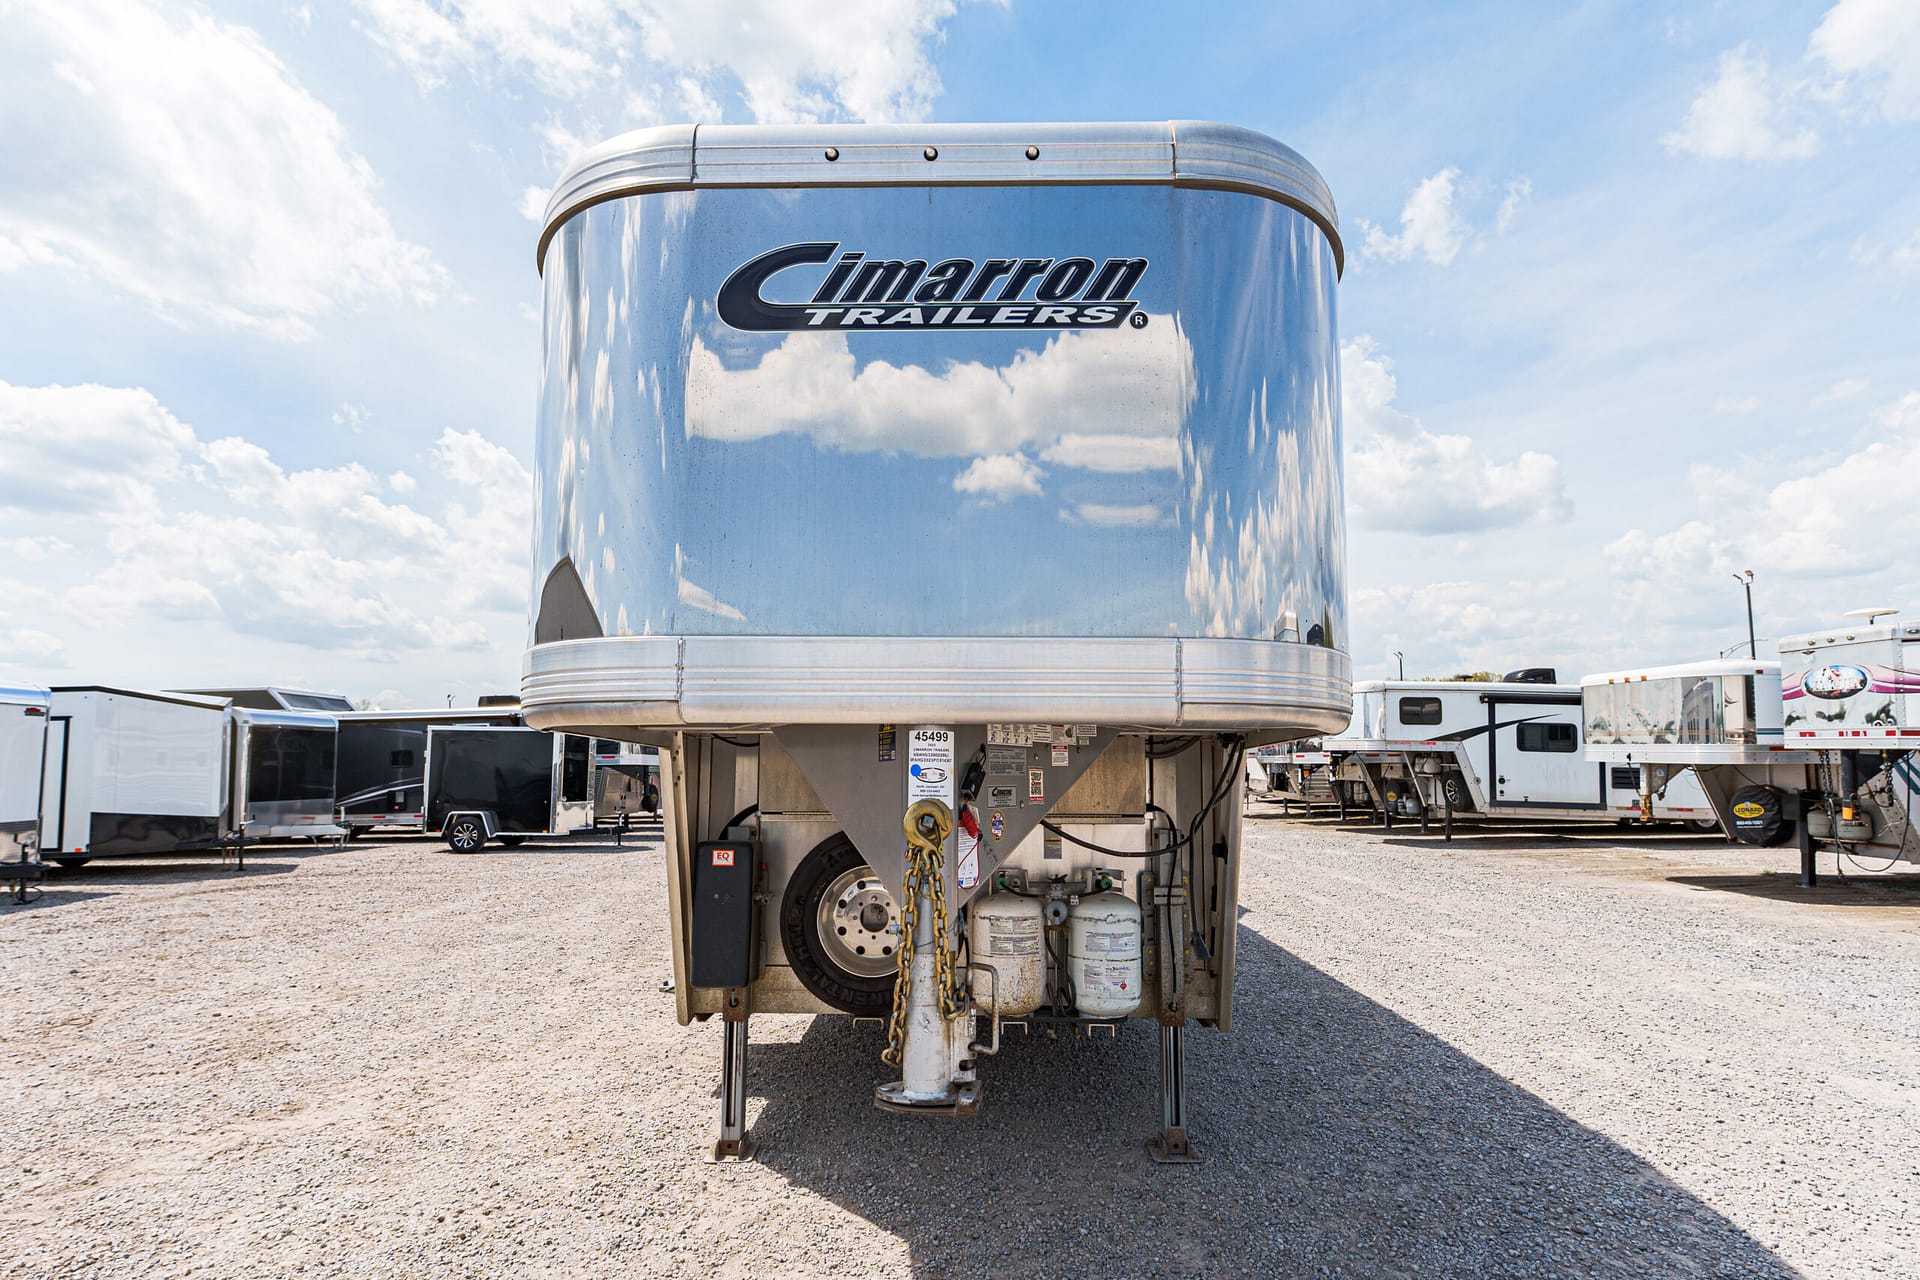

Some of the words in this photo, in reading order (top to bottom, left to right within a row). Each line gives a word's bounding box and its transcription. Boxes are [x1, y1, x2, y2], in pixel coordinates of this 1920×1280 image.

[717, 242, 1149, 331] Cimarron
[804, 306, 1120, 325] TRAILERS
[915, 731, 948, 742] 45499
[717, 852, 729, 861] EQ
